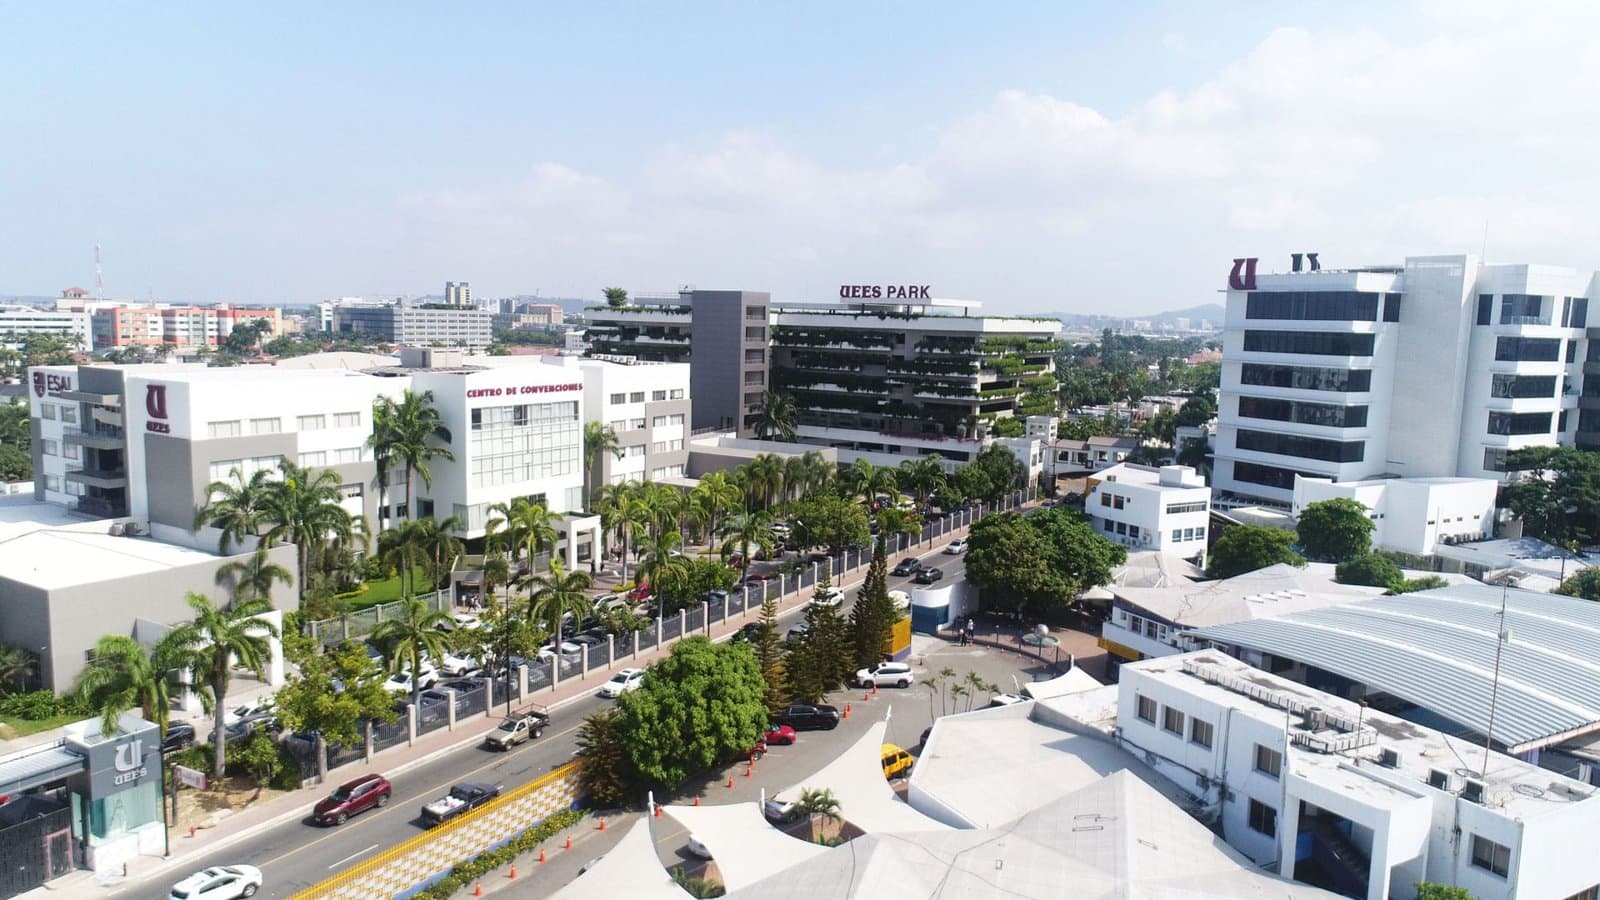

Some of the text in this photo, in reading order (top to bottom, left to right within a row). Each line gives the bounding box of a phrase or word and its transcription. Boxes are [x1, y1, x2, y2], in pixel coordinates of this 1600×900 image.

[840, 285, 930, 298] UEES PARK
[466, 383, 583, 398] CENTRO DE CONVENCIONES
[115, 767, 147, 785] UEES
